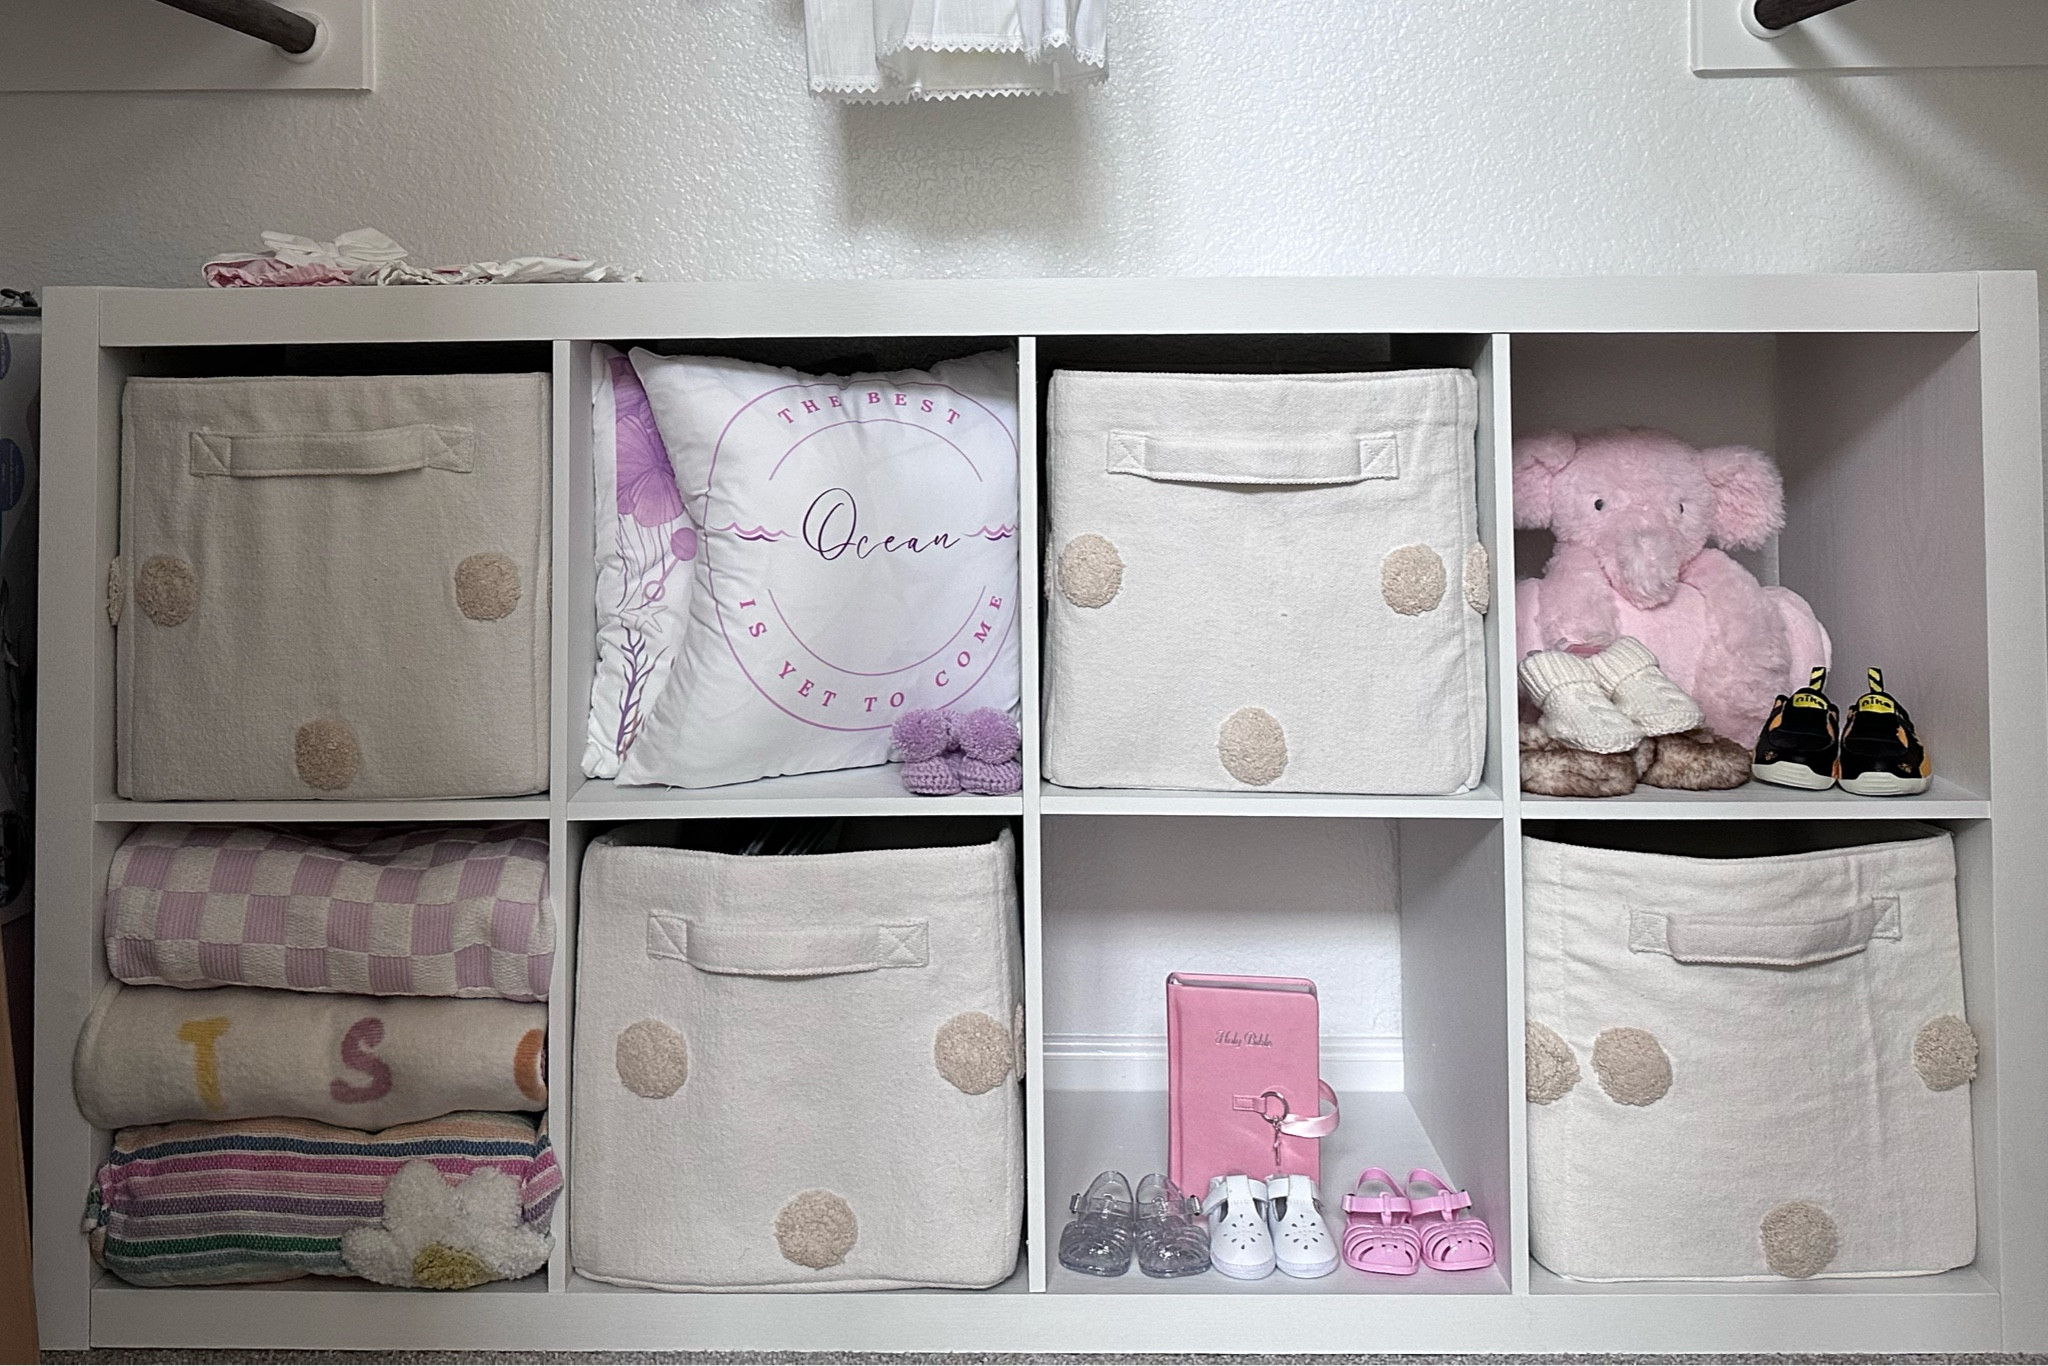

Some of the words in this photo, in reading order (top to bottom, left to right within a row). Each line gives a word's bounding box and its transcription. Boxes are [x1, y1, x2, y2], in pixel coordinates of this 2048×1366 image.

[777, 394, 845, 425] THE
[866, 391, 961, 425] BEST
[802, 487, 961, 561] Ocean
[738, 597, 768, 638] IS
[778, 660, 836, 708] YET
[863, 691, 905, 713] TO
[934, 594, 1003, 688] COME
[176, 1015, 231, 1111] T
[330, 1017, 393, 1104] S
[1214, 1029, 1242, 1048] Holy
[1243, 1030, 1273, 1048] Bible
